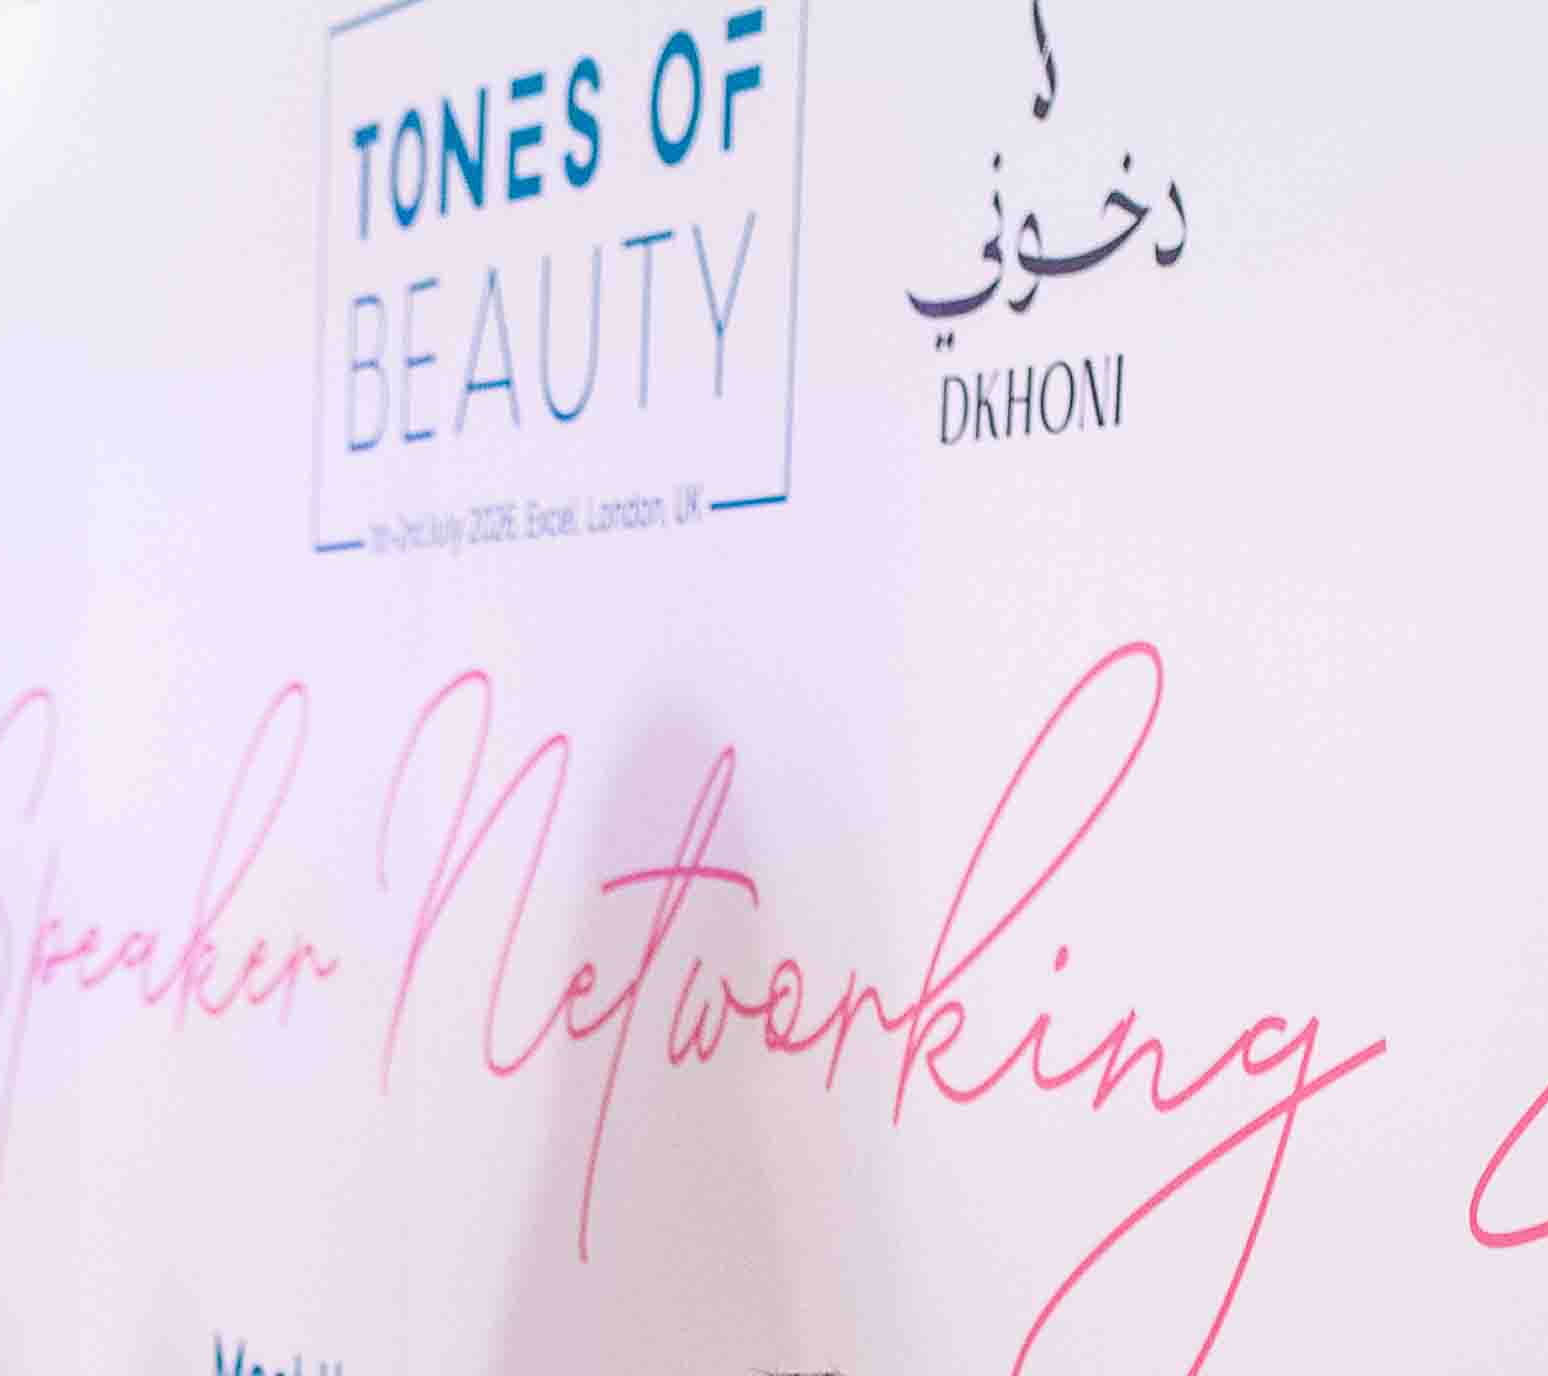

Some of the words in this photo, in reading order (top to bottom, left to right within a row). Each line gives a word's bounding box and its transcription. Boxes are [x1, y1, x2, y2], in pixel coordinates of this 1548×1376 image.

[352, 57, 603, 240] TONES
[649, 7, 767, 168] OF
[345, 210, 757, 453] BEAUTY
[939, 354, 1125, 445] DKHONI
